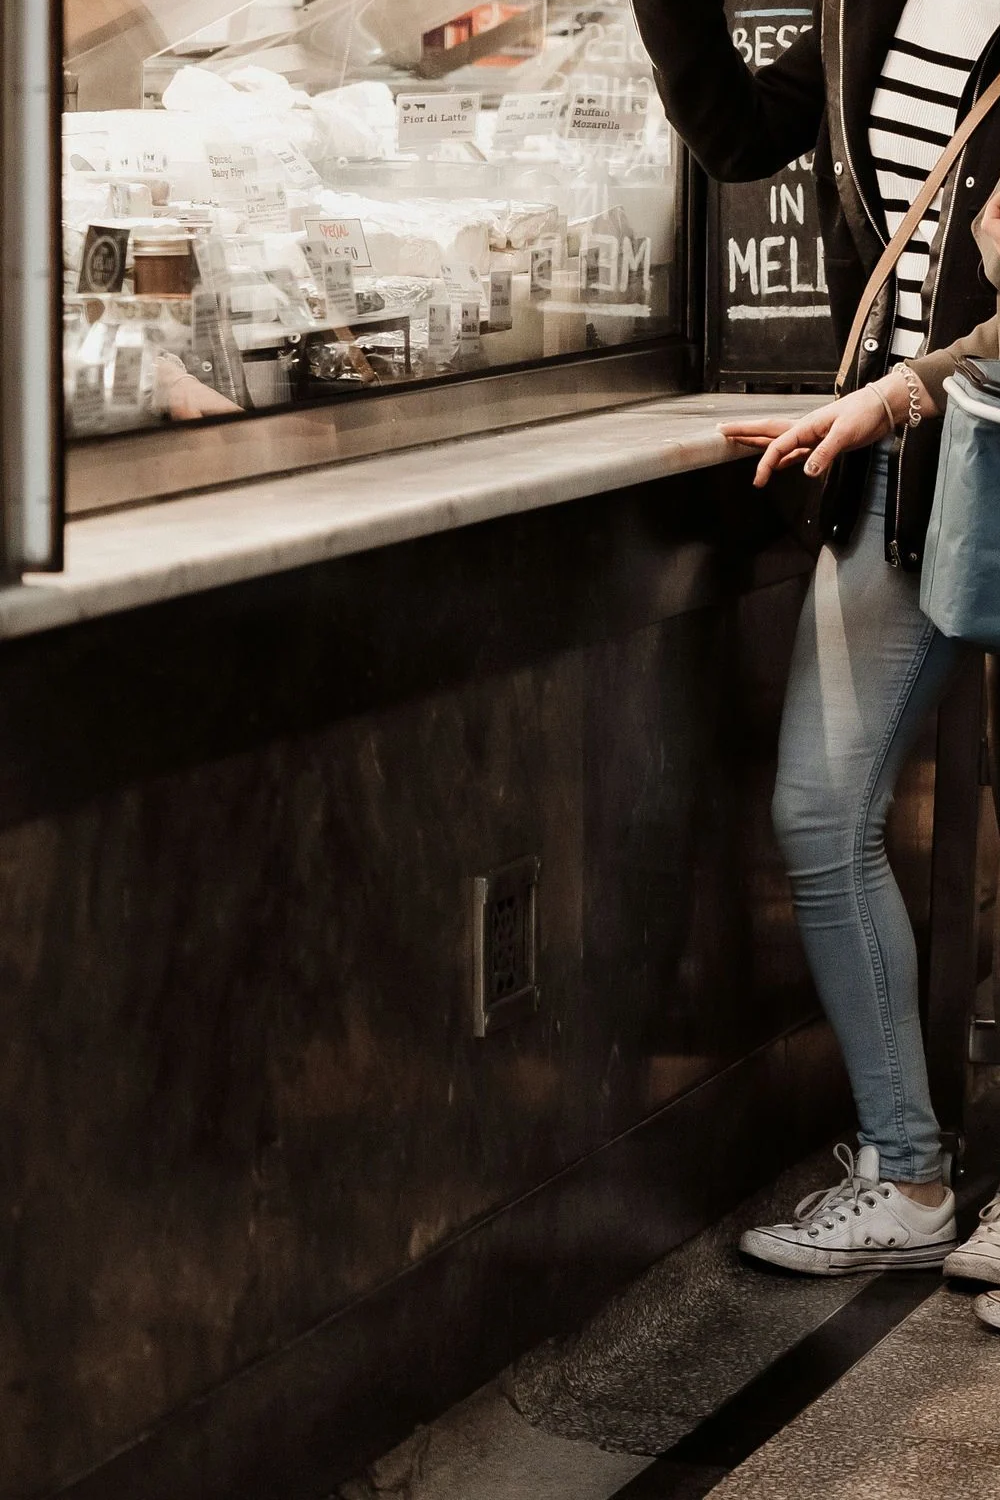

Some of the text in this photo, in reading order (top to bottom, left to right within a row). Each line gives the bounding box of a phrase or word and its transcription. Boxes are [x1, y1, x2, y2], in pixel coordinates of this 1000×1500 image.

[403, 112, 468, 124] Fior di Latte
[574, 108, 610, 118] Buffalo
[572, 120, 621, 131] Mozarella
[770, 183, 804, 225] IN
